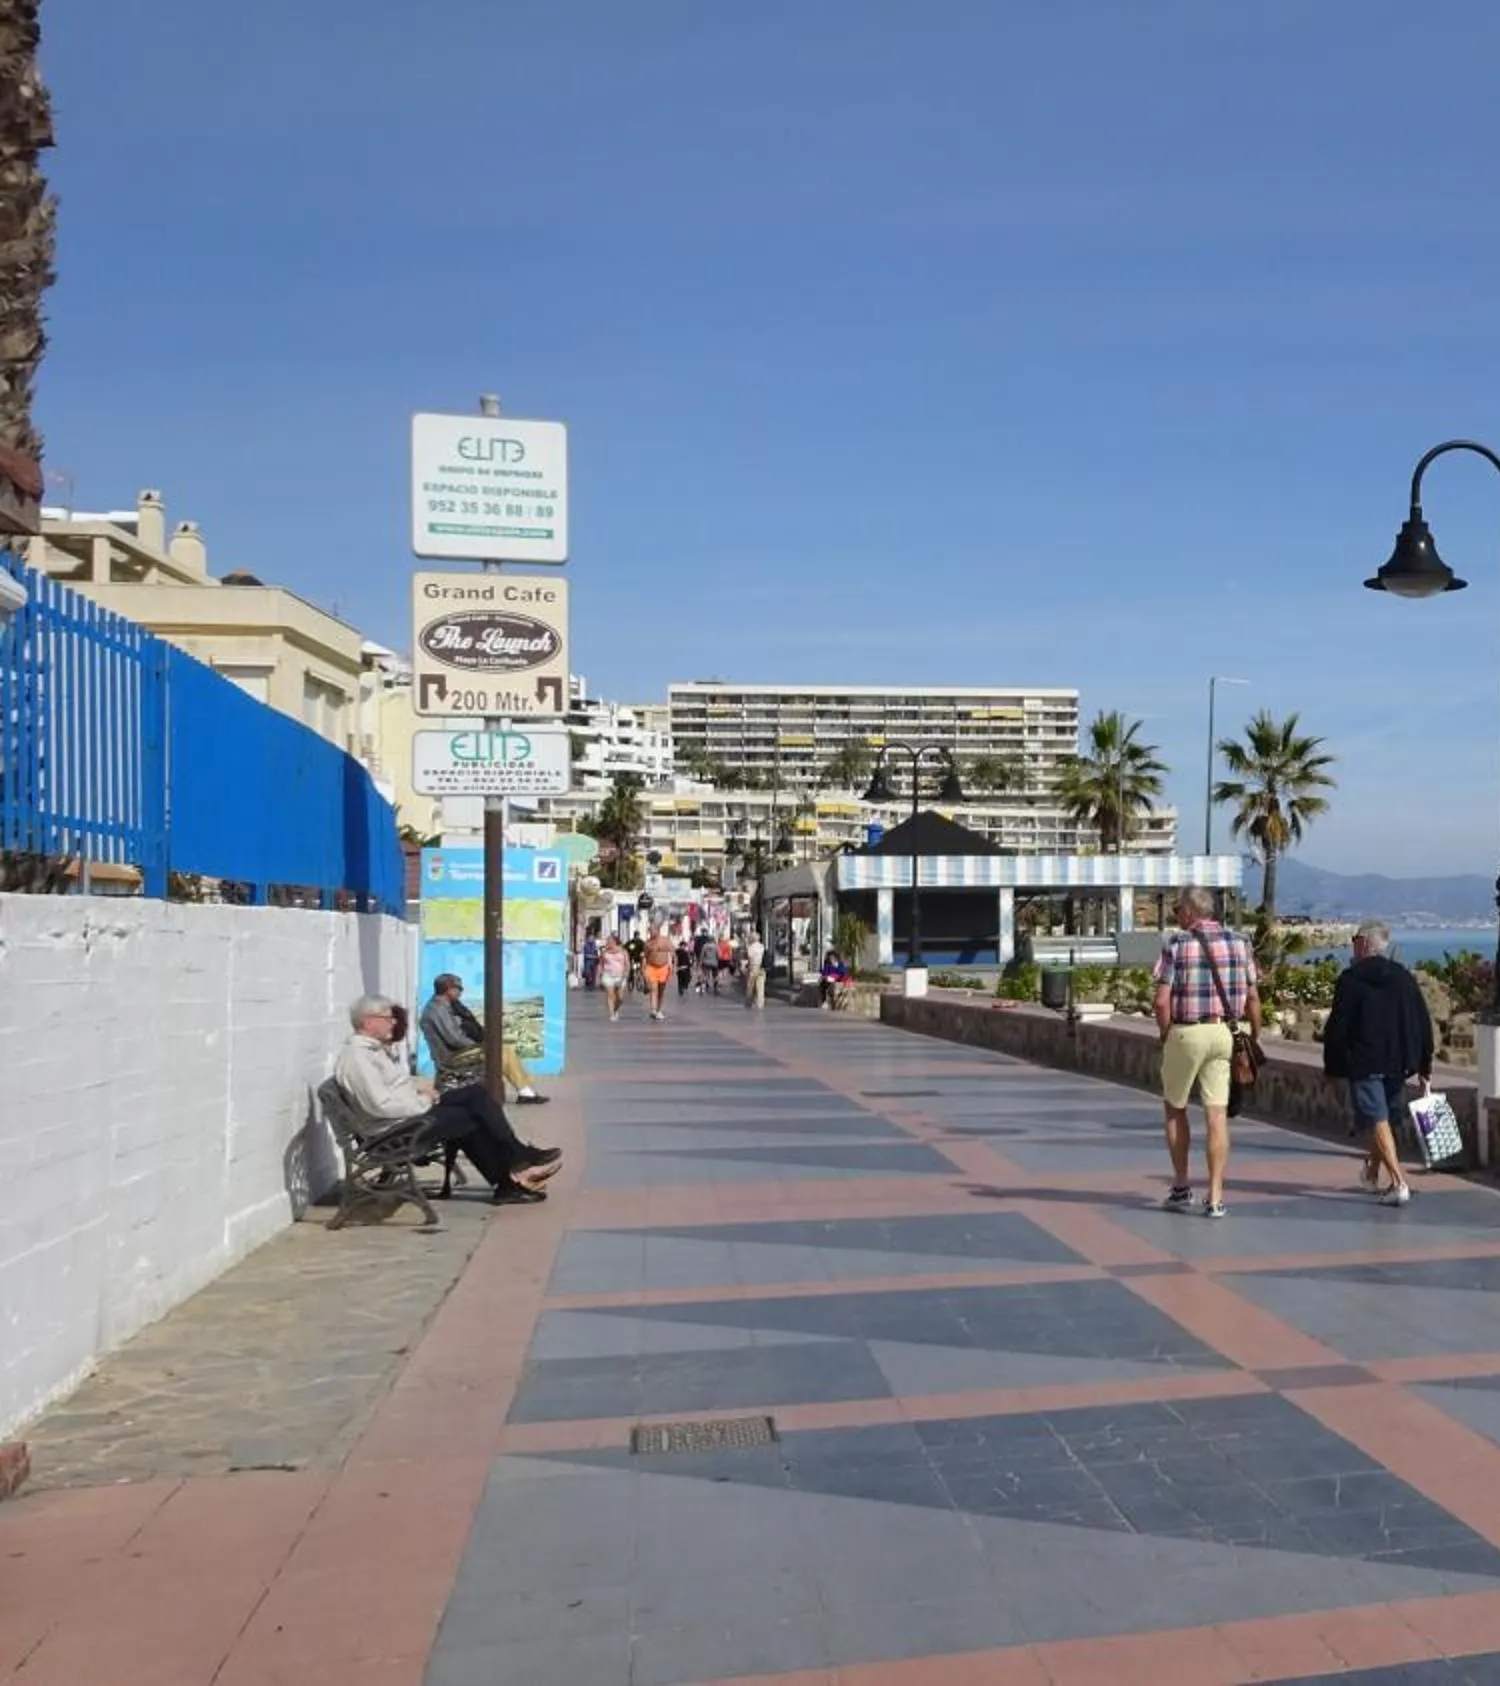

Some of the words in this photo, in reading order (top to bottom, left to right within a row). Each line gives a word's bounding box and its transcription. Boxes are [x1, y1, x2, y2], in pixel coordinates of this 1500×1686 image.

[458, 436, 526, 463] ELITE
[423, 482, 478, 495] ESPACIO
[482, 486, 558, 499] DISPONIBLE
[428, 499, 456, 513] 952
[460, 501, 478, 514] 35
[483, 502, 501, 516] 36
[423, 583, 495, 601] Grand
[503, 585, 557, 603] Cafe
[427, 624, 474, 650] The
[451, 690, 487, 711] 200
[495, 691, 534, 712] Mtr.
[450, 732, 532, 760] ELITE
[452, 761, 536, 769] PUBLICIDAD
